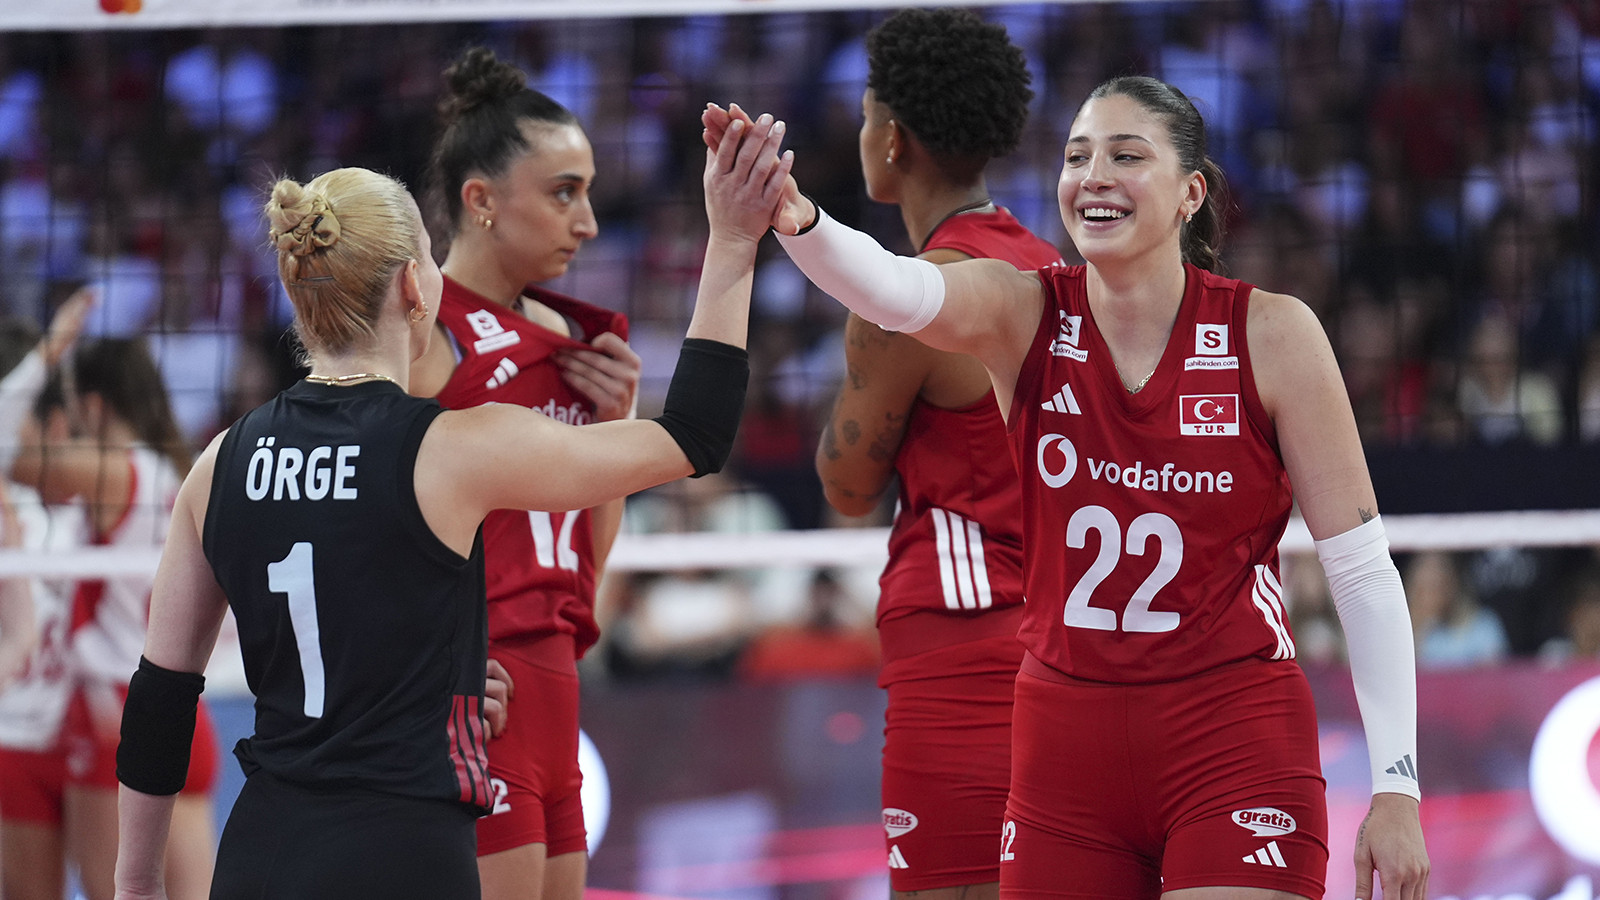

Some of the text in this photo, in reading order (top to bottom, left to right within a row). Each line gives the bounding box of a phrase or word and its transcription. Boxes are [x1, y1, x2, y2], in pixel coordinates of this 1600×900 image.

[1060, 317, 1073, 337] S
[1203, 330, 1221, 348] S
[1194, 425, 1226, 433] TUR
[245, 436, 361, 501] ÖRGE
[1087, 457, 1234, 493] vodafone
[1063, 504, 1184, 633] 22
[266, 541, 326, 719] 1
[487, 778, 512, 815] 2
[883, 812, 913, 828] ratis
[1238, 810, 1292, 829] gratis
